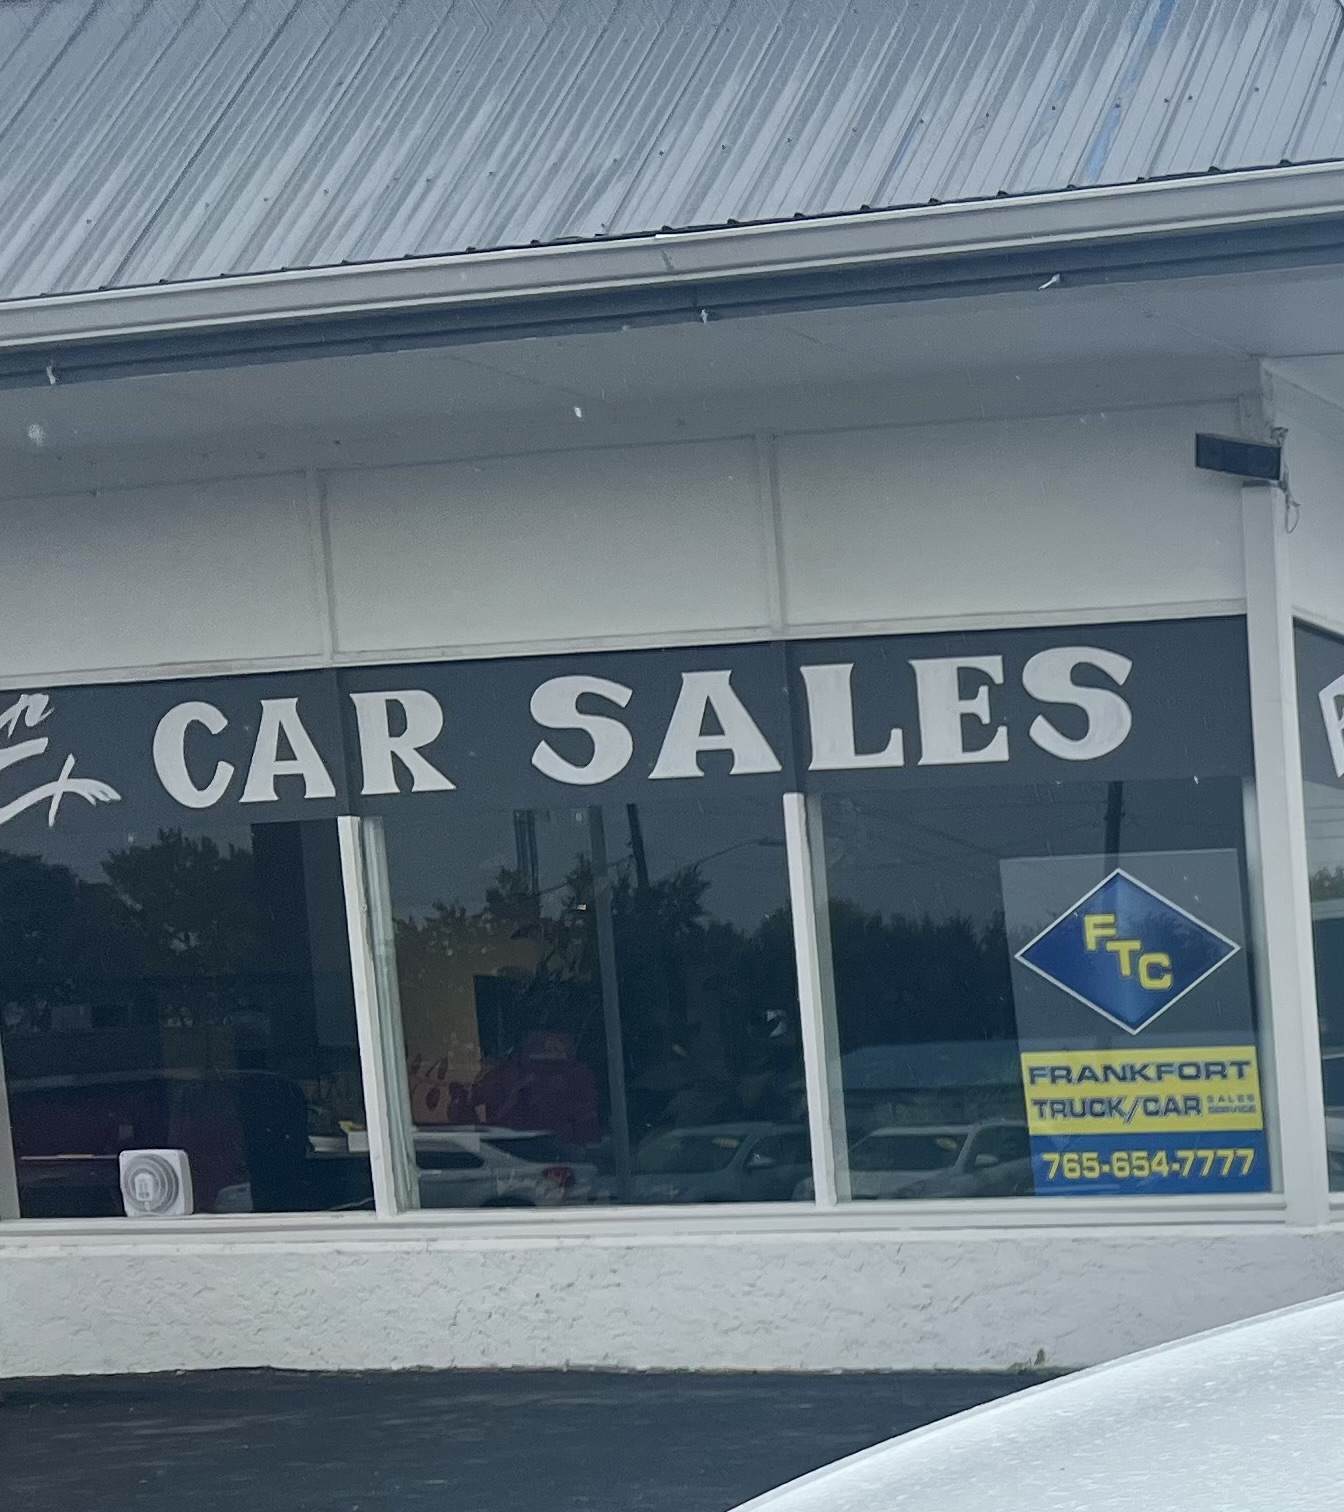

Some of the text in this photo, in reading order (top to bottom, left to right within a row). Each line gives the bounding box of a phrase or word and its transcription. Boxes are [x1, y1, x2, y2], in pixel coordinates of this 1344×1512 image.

[153, 645, 1133, 809] CAR SALES
[1082, 912, 1174, 991] FTC
[1028, 1059, 1252, 1085] FRANKFORT
[1032, 1094, 1202, 1125] TRUCK/CAR
[1041, 1148, 1256, 1181] 765-654-7777
